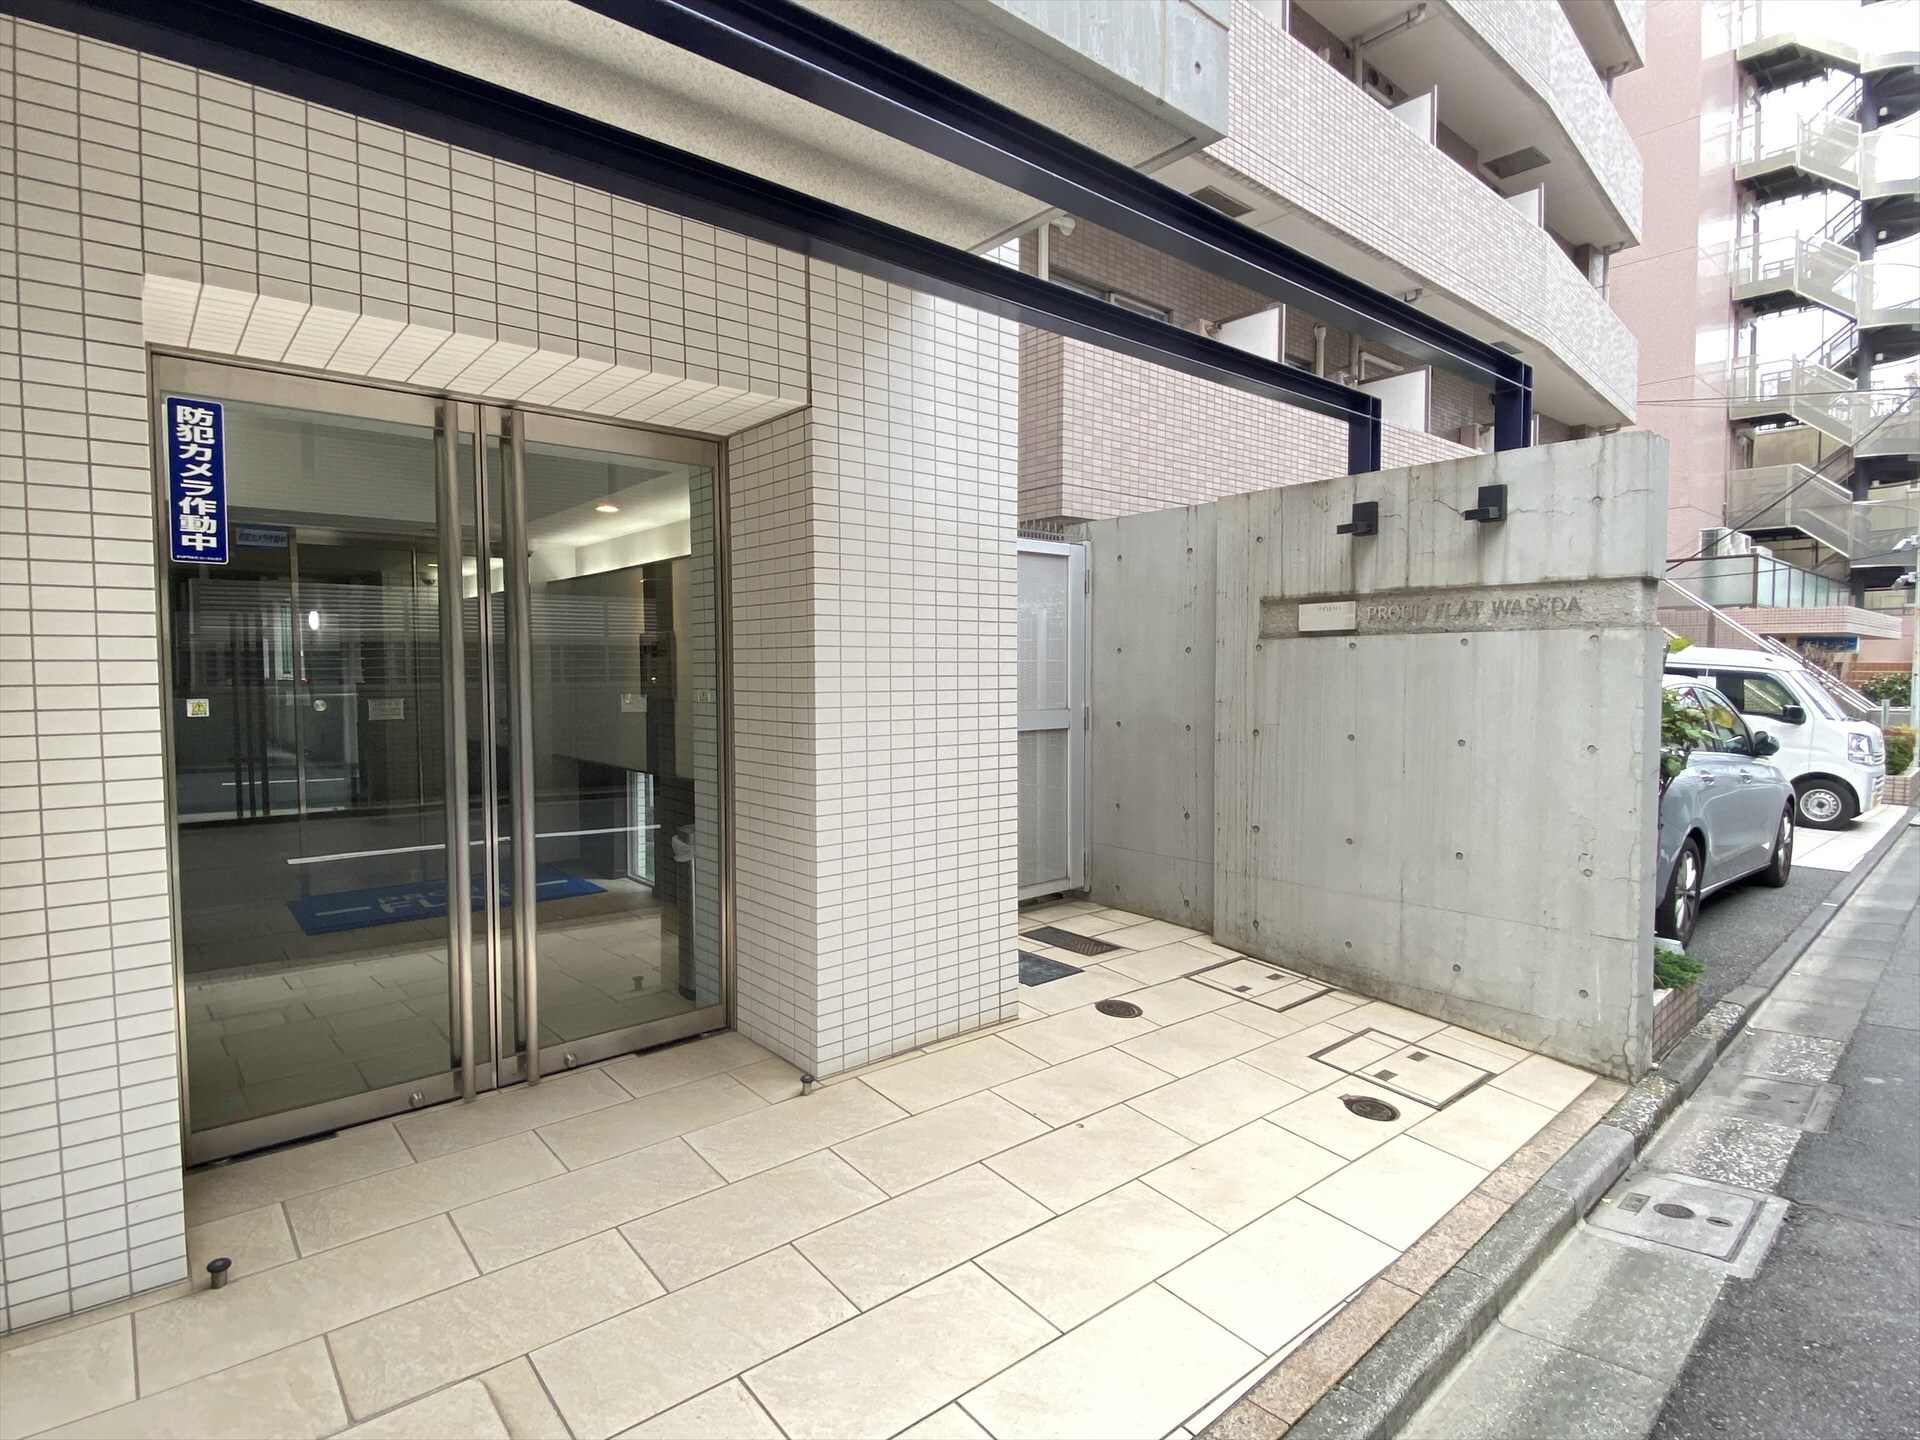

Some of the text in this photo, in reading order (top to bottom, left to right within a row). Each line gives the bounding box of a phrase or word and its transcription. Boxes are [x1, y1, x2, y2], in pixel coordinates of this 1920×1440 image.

[175, 404, 218, 552] 防犯カメラ作動中
[1366, 596, 1583, 625] PROUD FLAT WASEDA
